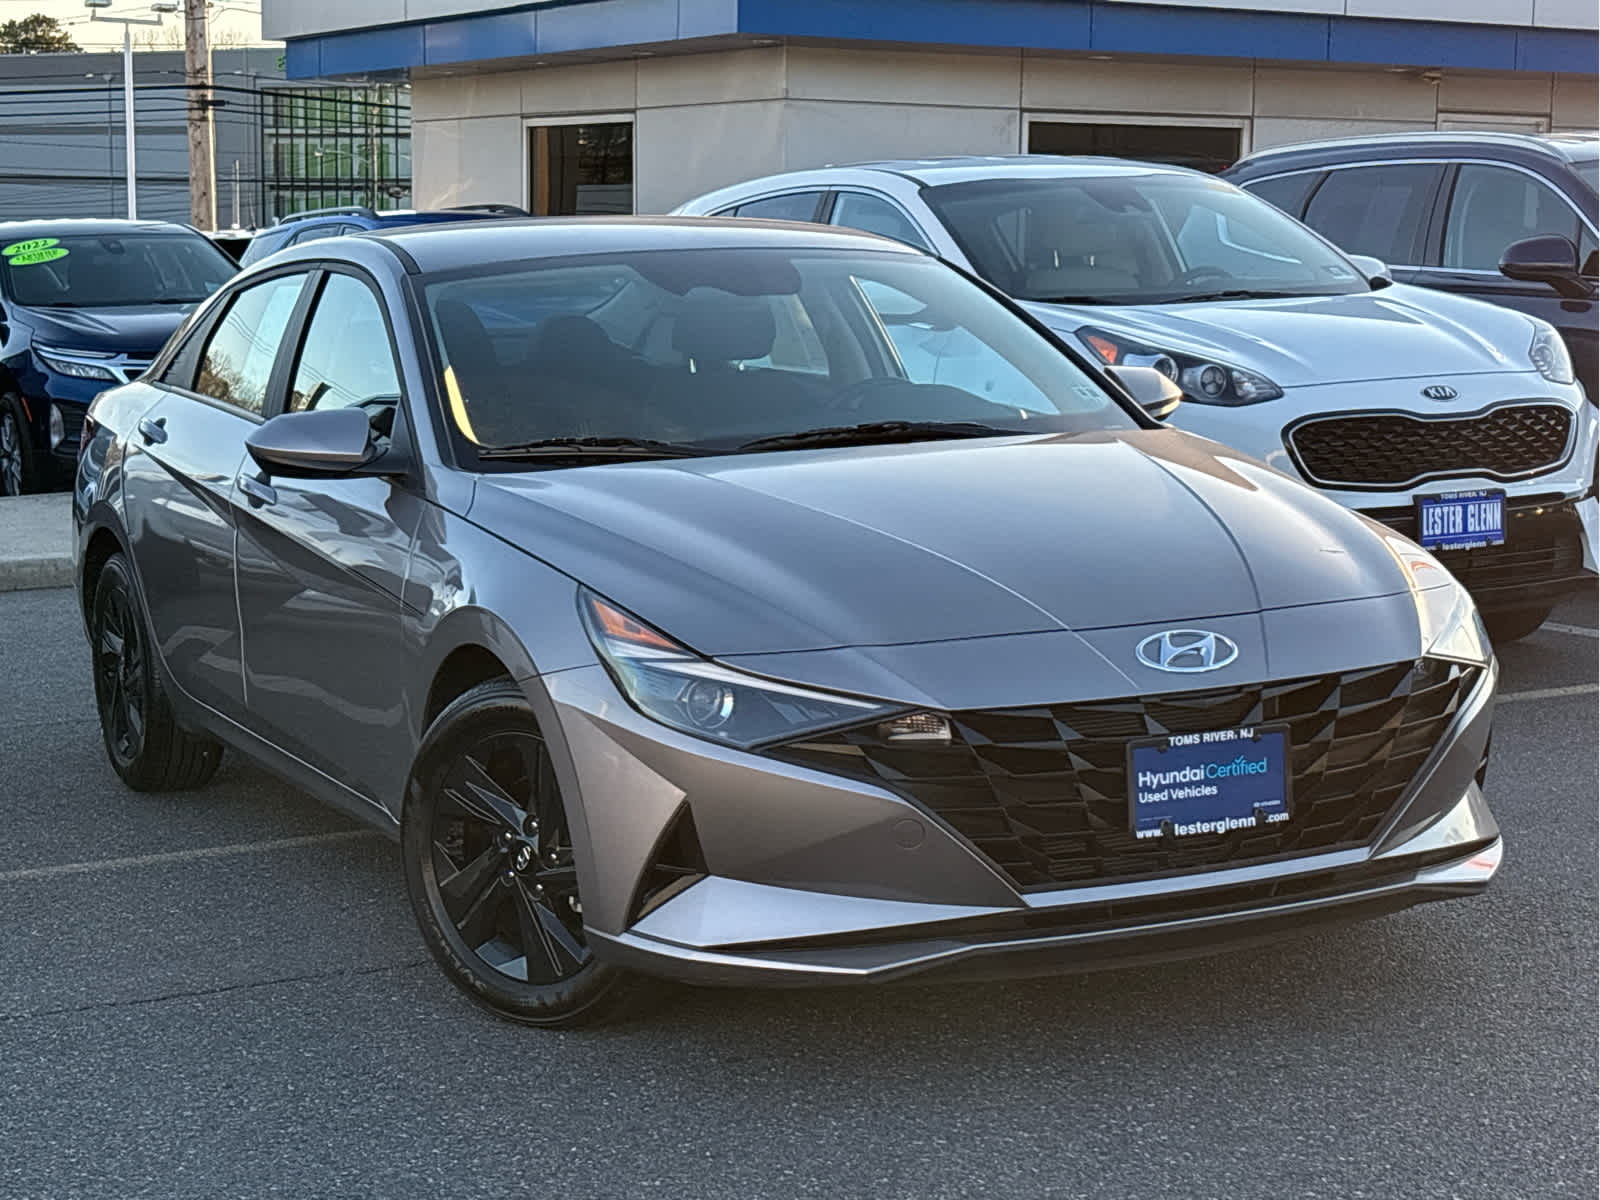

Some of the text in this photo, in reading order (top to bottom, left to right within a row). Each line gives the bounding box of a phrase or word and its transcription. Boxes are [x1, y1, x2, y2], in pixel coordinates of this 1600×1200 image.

[14, 240, 48, 253] 2022
[1427, 386, 1456, 398] KIA
[1423, 502, 1502, 536] LESTER GLENN
[1168, 734, 1200, 747] TOMS
[1240, 728, 1254, 738] NJ
[1138, 756, 1267, 789] Hyundai Certified
[1139, 785, 1218, 803] Used Vehicles
[1174, 816, 1256, 836] lesterglenn
[1265, 812, 1289, 823] .com
